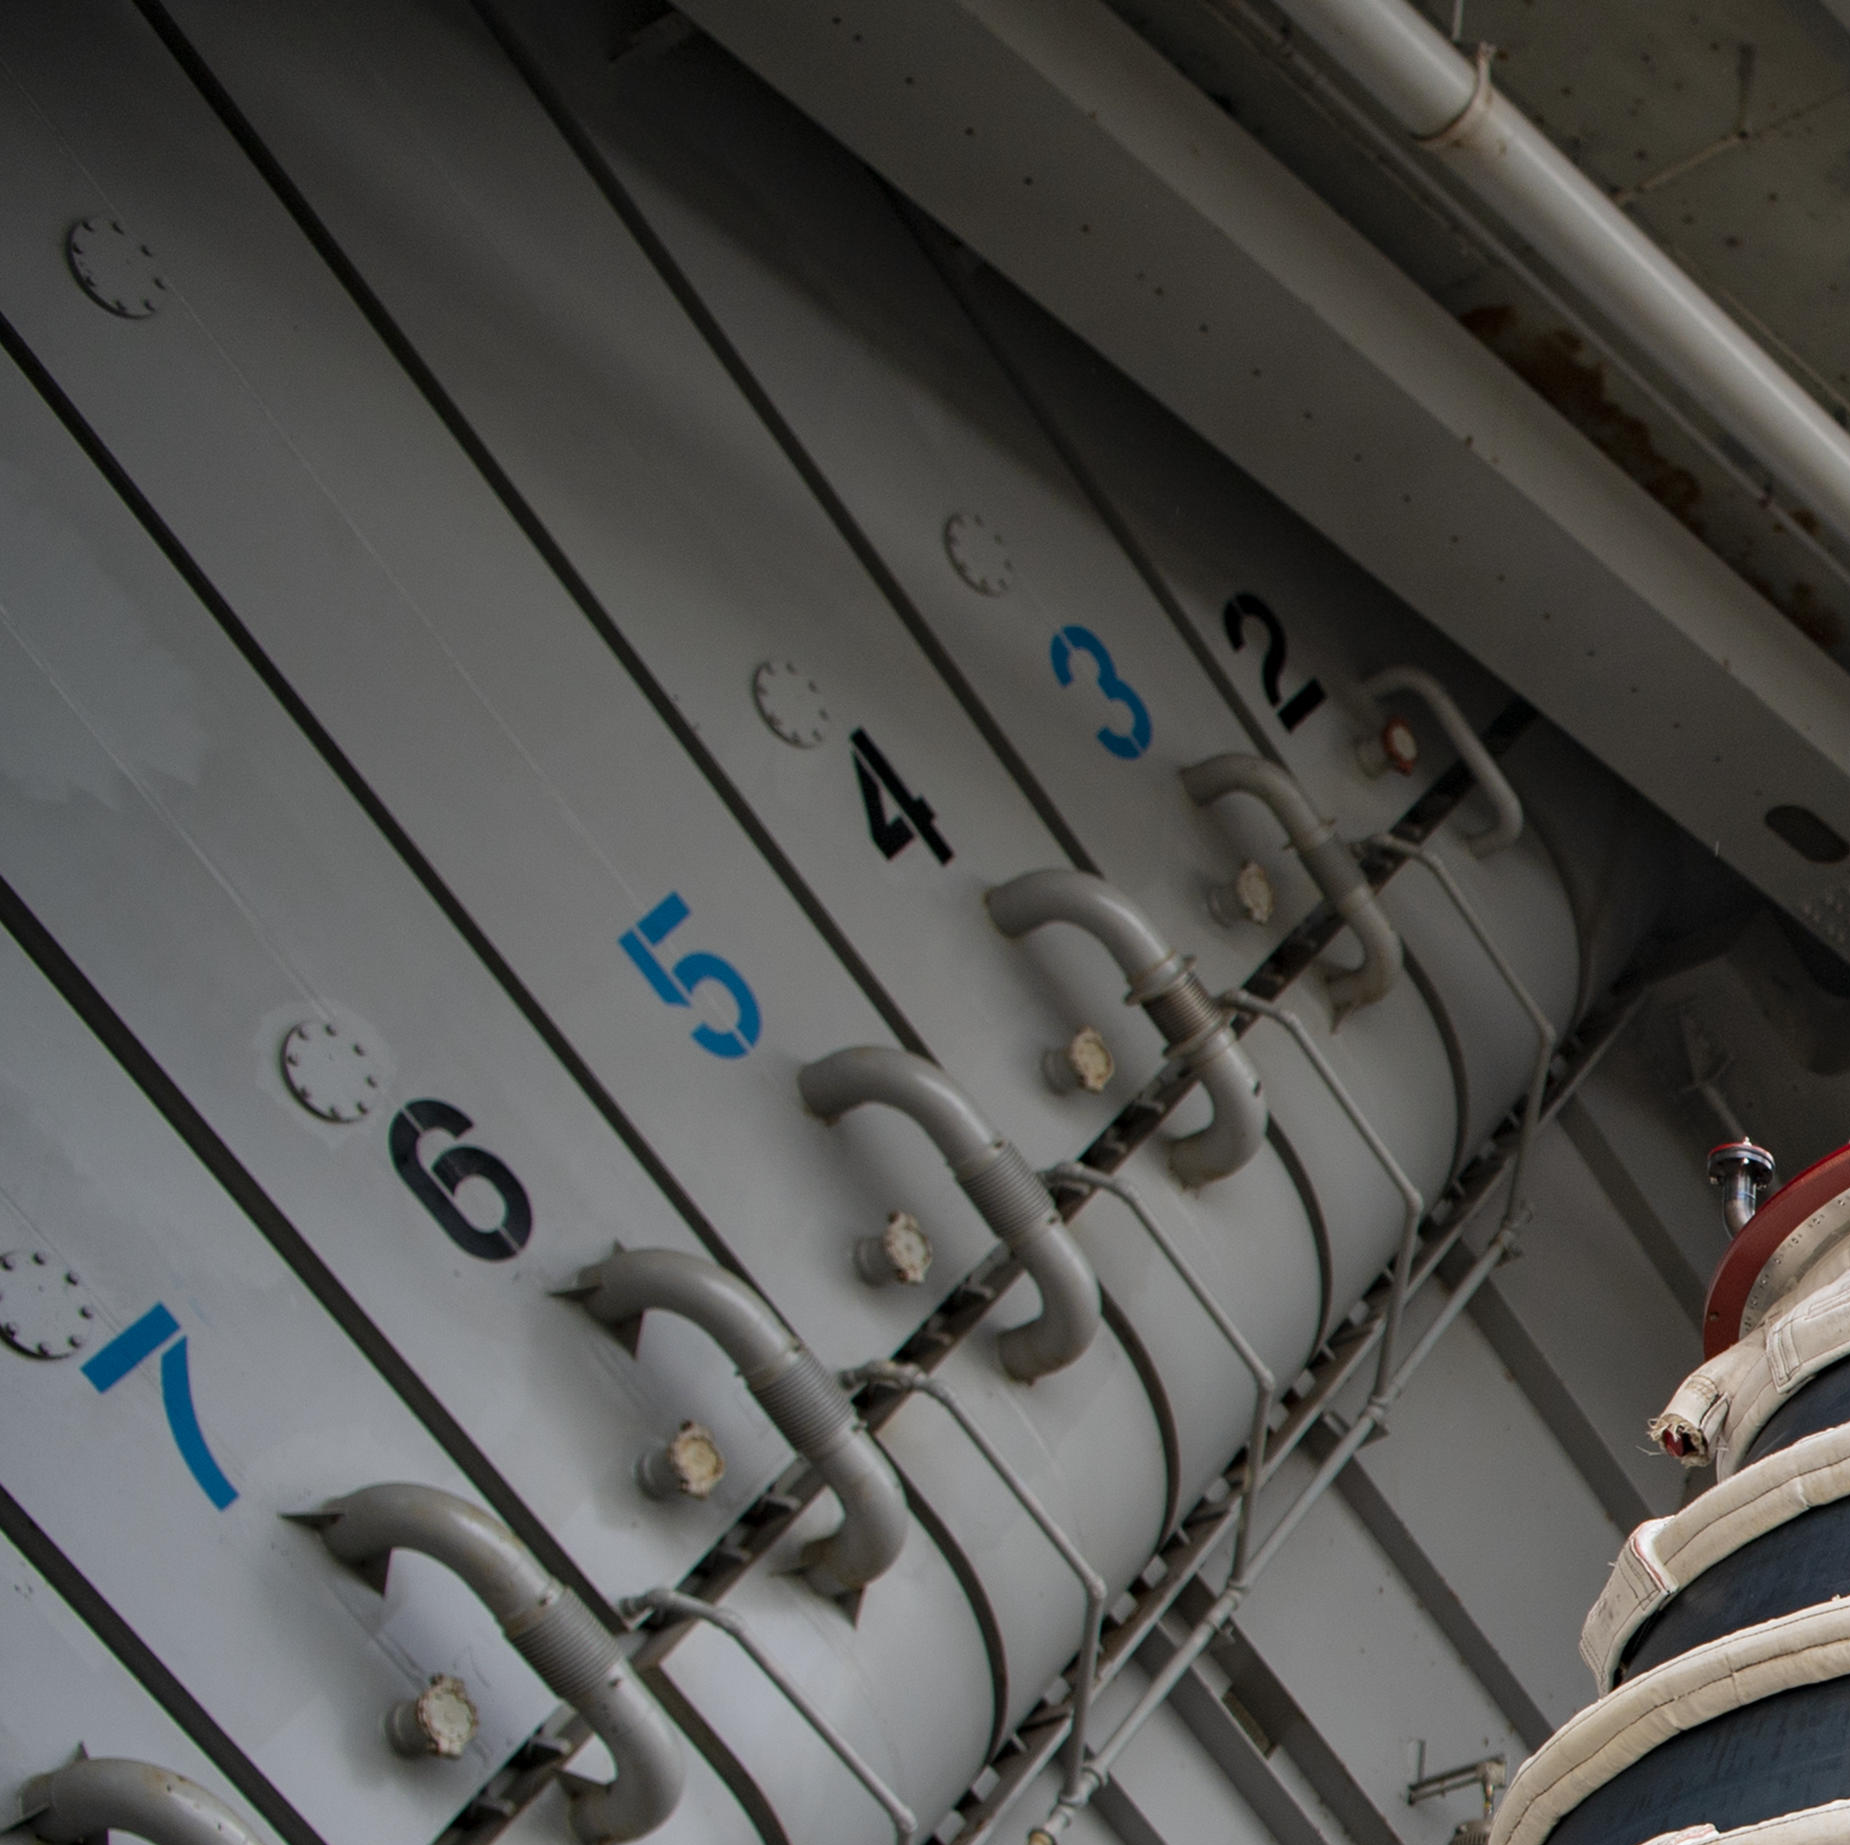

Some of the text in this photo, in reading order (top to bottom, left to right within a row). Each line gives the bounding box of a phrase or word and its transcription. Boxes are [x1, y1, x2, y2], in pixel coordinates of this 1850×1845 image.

[1050, 624, 1152, 760] 3
[1223, 592, 1327, 733] 2
[850, 727, 953, 866] 4
[618, 891, 761, 1059] 5
[389, 1098, 533, 1261] 6
[80, 1302, 239, 1510] 7
